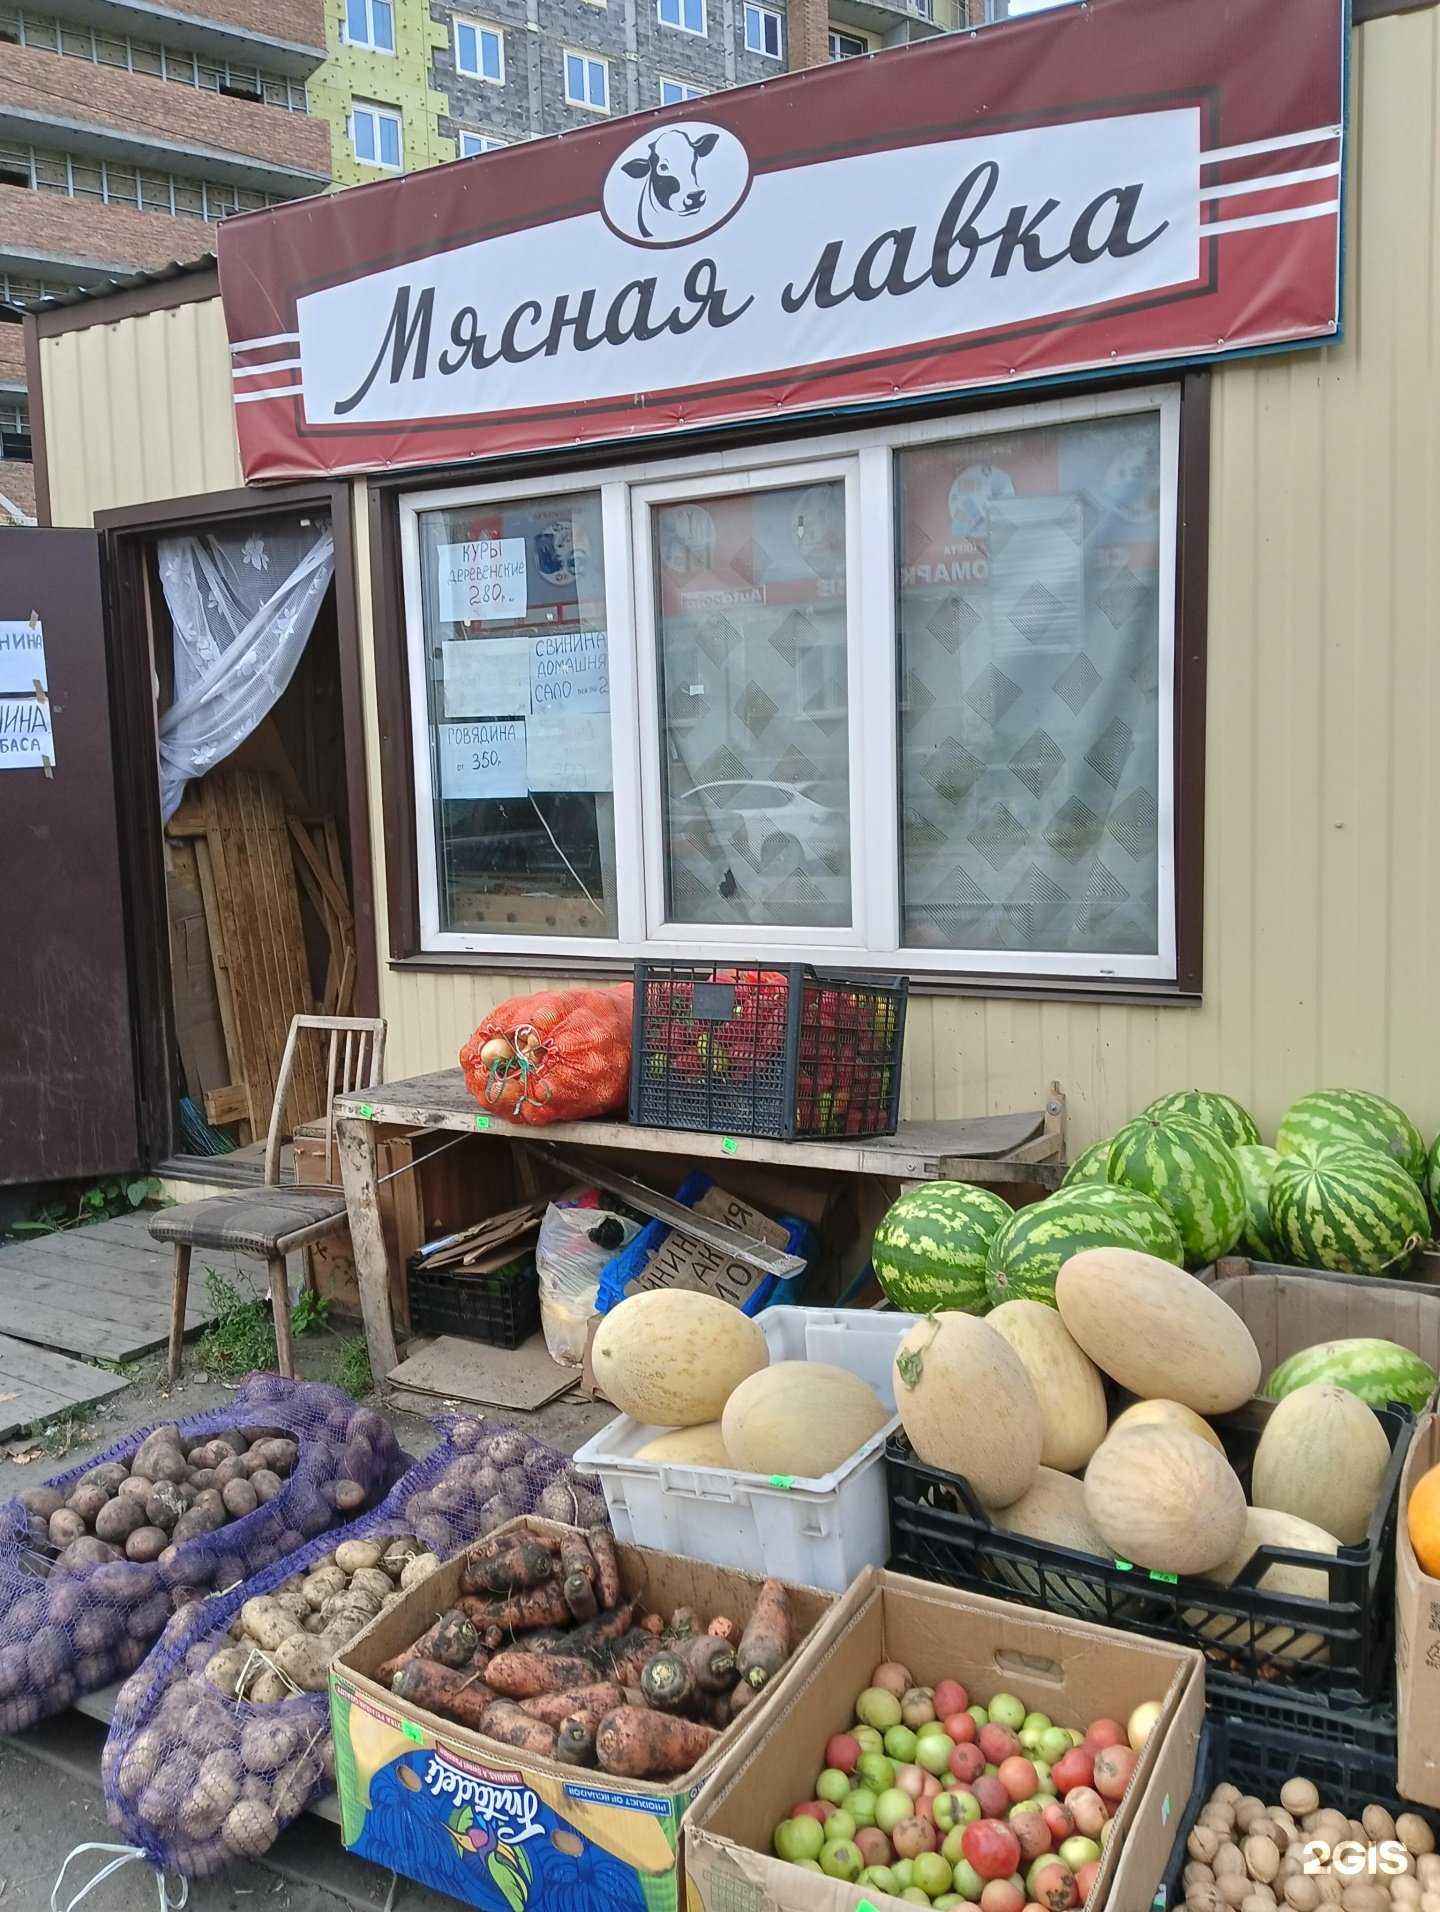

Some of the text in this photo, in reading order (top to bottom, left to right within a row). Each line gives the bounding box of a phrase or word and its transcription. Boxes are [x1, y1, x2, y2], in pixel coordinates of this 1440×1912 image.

[334, 160, 1170, 415] Мясная лавка
[463, 541, 502, 562] КУРЫ
[448, 561, 525, 583] ДЕРЕВЕНСКИЕ
[535, 632, 607, 657] СВИНИНА
[535, 680, 572, 703] САЛО
[0, 705, 48, 734] ИНА
[448, 724, 516, 745] ГОВЯДИНА
[691, 1202, 754, 1286] АКИЯ
[642, 1230, 699, 1292] ИНИН
[714, 1260, 754, 1302] 10
[424, 1759, 546, 1845] Frutadeli
